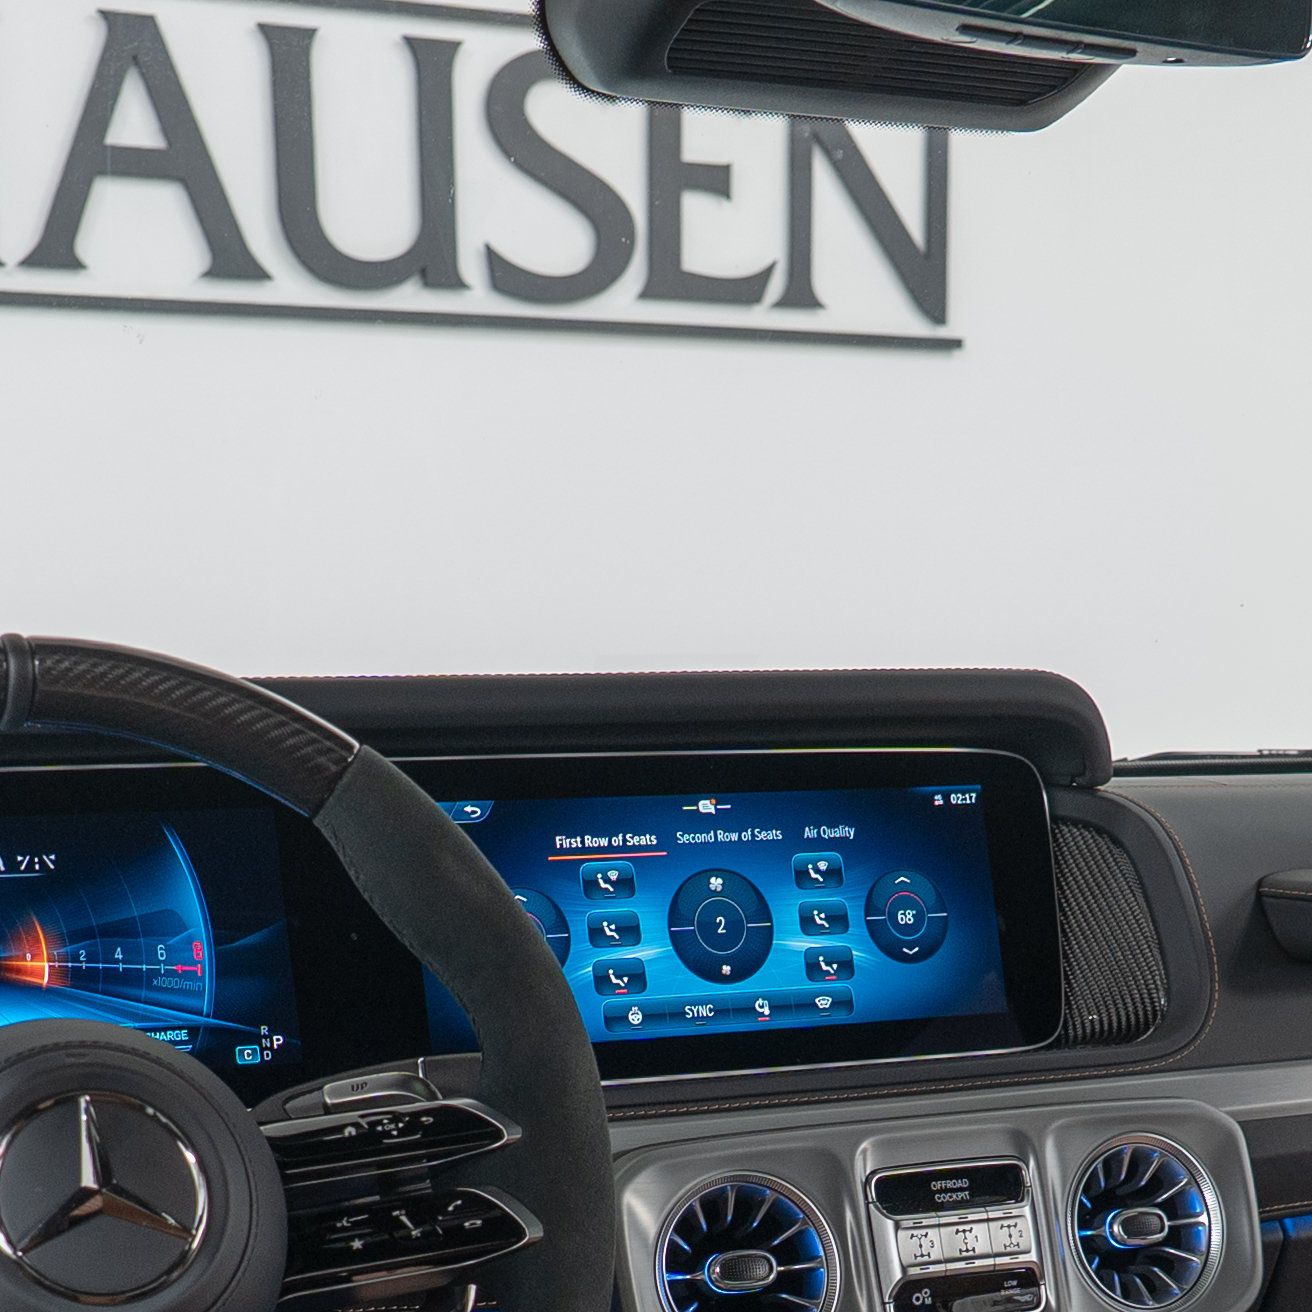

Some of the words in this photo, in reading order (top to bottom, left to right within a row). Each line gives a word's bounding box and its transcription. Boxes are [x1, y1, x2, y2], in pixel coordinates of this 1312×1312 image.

[950, 792, 977, 805] 02:17
[676, 830, 715, 844] Second
[717, 829, 739, 843] Row
[741, 828, 753, 841] of
[754, 828, 783, 841] Seats
[803, 825, 818, 839] Air
[820, 825, 856, 840] Quality
[555, 835, 582, 849] First
[584, 834, 609, 847] Row
[611, 833, 624, 846] of
[626, 833, 658, 847] Seats
[716, 916, 727, 934] 2
[79, 950, 87, 961] 2
[114, 947, 123, 960] 4
[157, 944, 167, 961] 6
[684, 1004, 715, 1018] SYNC
[260, 1025, 269, 1035] R
[262, 1038, 271, 1048] N
[272, 1035, 283, 1049] P
[244, 1050, 253, 1060] C
[264, 1050, 272, 1061] D
[350, 1081, 368, 1092] UP
[384, 1123, 396, 1131] OK
[930, 1178, 969, 1191] OFFROAD
[934, 1191, 970, 1203] COCKPIT
[974, 1235, 979, 1243] 1
[1018, 1230, 1024, 1238] 2
[929, 1239, 935, 1249] 3
[1003, 1279, 1018, 1287] LOW
